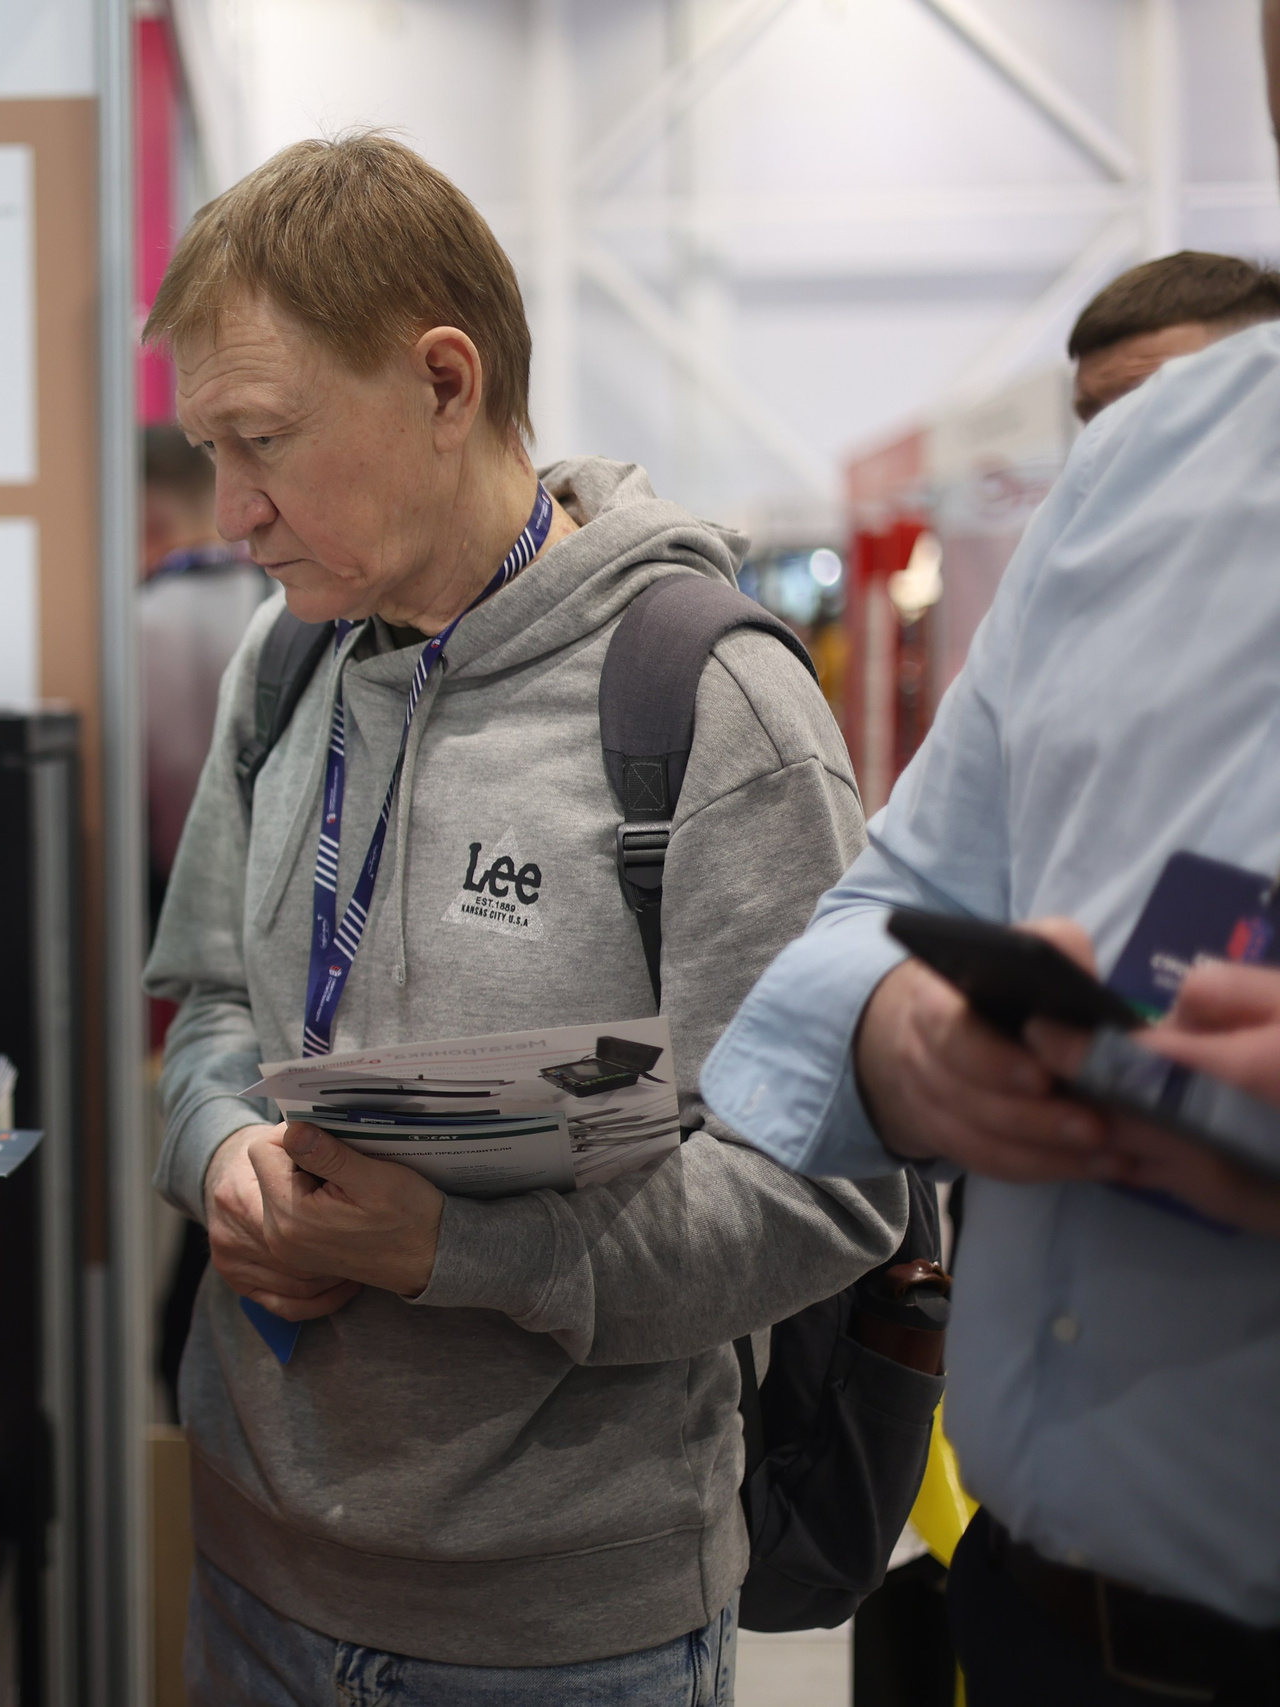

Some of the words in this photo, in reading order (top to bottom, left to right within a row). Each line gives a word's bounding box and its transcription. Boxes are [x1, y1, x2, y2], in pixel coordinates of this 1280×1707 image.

[463, 842, 542, 905] Lee
[461, 904, 488, 918] KANSAS
[489, 910, 506, 922] CITY
[435, 1146, 512, 1156] ПРЕДСТАВИТЕЛИ
